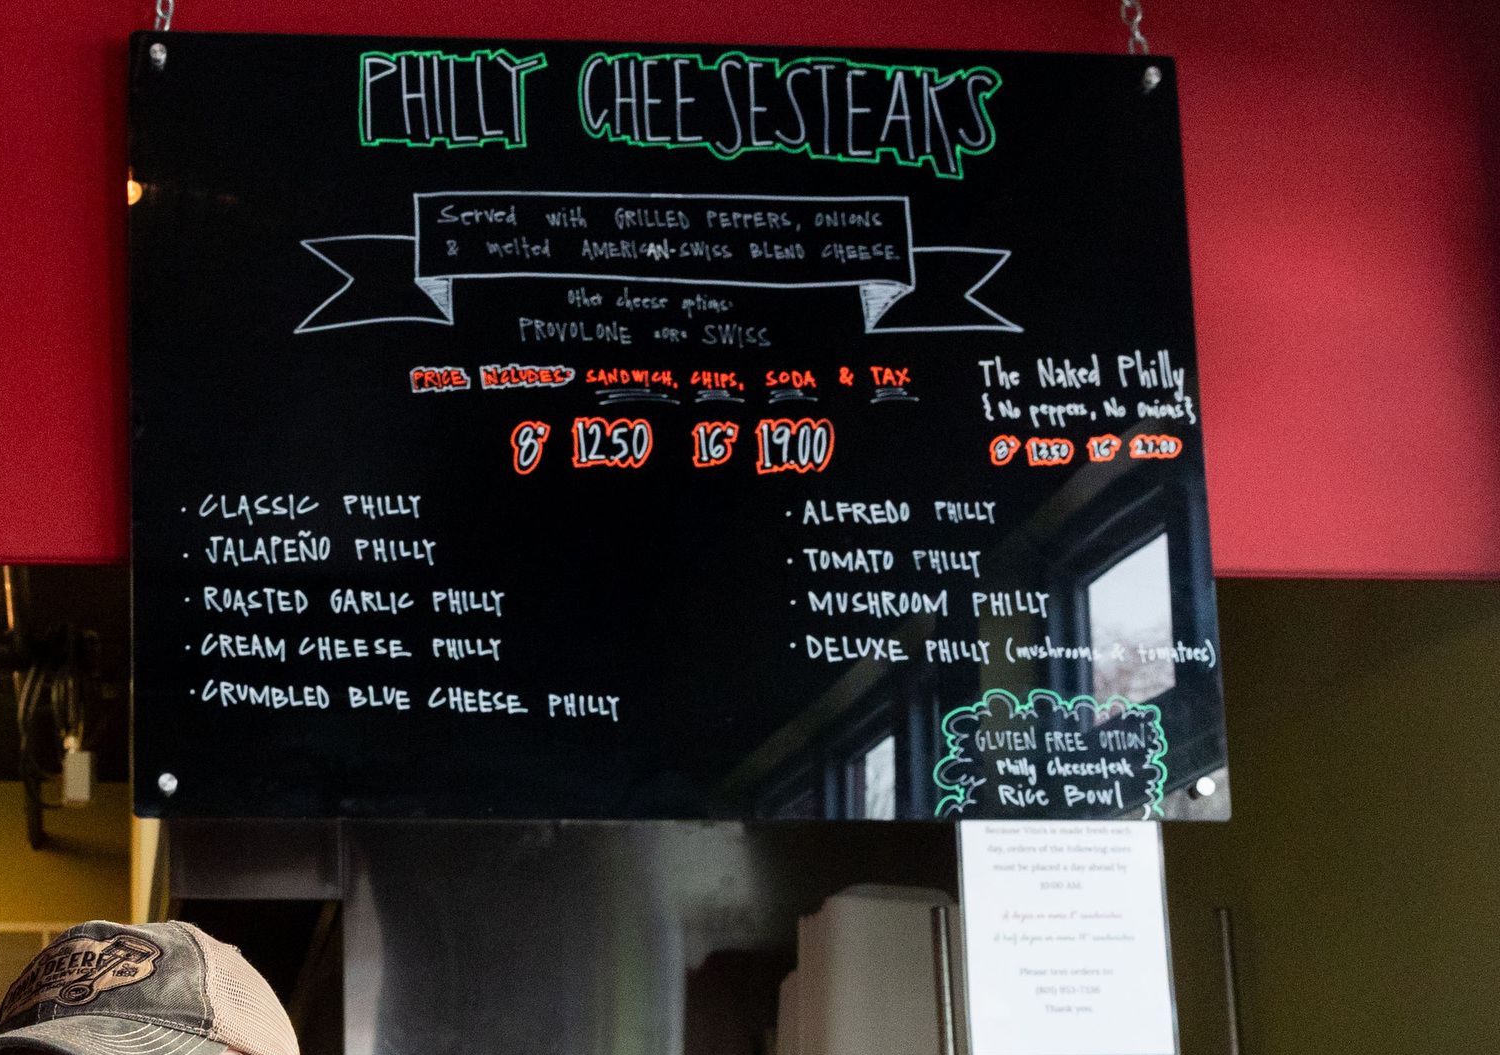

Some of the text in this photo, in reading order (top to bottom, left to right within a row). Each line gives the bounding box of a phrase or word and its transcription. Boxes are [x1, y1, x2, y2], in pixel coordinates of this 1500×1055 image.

[361, 54, 995, 176] PHILLY CHEESESTEAKS
[436, 204, 883, 232] Served with GRILLED PEPPERS, ONIONS
[445, 239, 460, 257] &
[486, 238, 553, 258] melted
[581, 239, 733, 260] AMERICAN-SWISS
[749, 241, 806, 260] BLEND
[567, 289, 603, 307] Other
[615, 292, 669, 311] cheese
[518, 317, 633, 345] PROVOLONE
[701, 323, 772, 349] SWISS
[412, 369, 468, 389] PRICE
[765, 370, 816, 388] SODA
[838, 368, 854, 386] &
[870, 366, 911, 386] TAX
[978, 349, 1184, 401] The Naked Philly
[1103, 397, 1126, 418] No
[517, 422, 829, 470] 8" 12.50 16" 19.00
[199, 494, 421, 525] CLASSIC PHILLY
[802, 499, 997, 525] ALFREDO PHILLY
[205, 530, 437, 567] JALAPEÑO PHILLY
[803, 548, 981, 579] TOMATO PHILLY
[203, 586, 505, 617] ROASTED GARLIC PHILLY
[808, 589, 1050, 618] MUSHROOM PHILLY
[201, 633, 502, 662] CREAM CHEESE PHILLY
[806, 634, 909, 663] DELUXE
[925, 639, 990, 665] PHILLY
[201, 679, 619, 721] CRUMBLED BLUE CHEESE PHILLY
[975, 722, 1147, 753] GLUTEN FREE OPTION
[996, 756, 1135, 785] Philly Cheesesteak
[998, 781, 1124, 809] Rice Bowl
